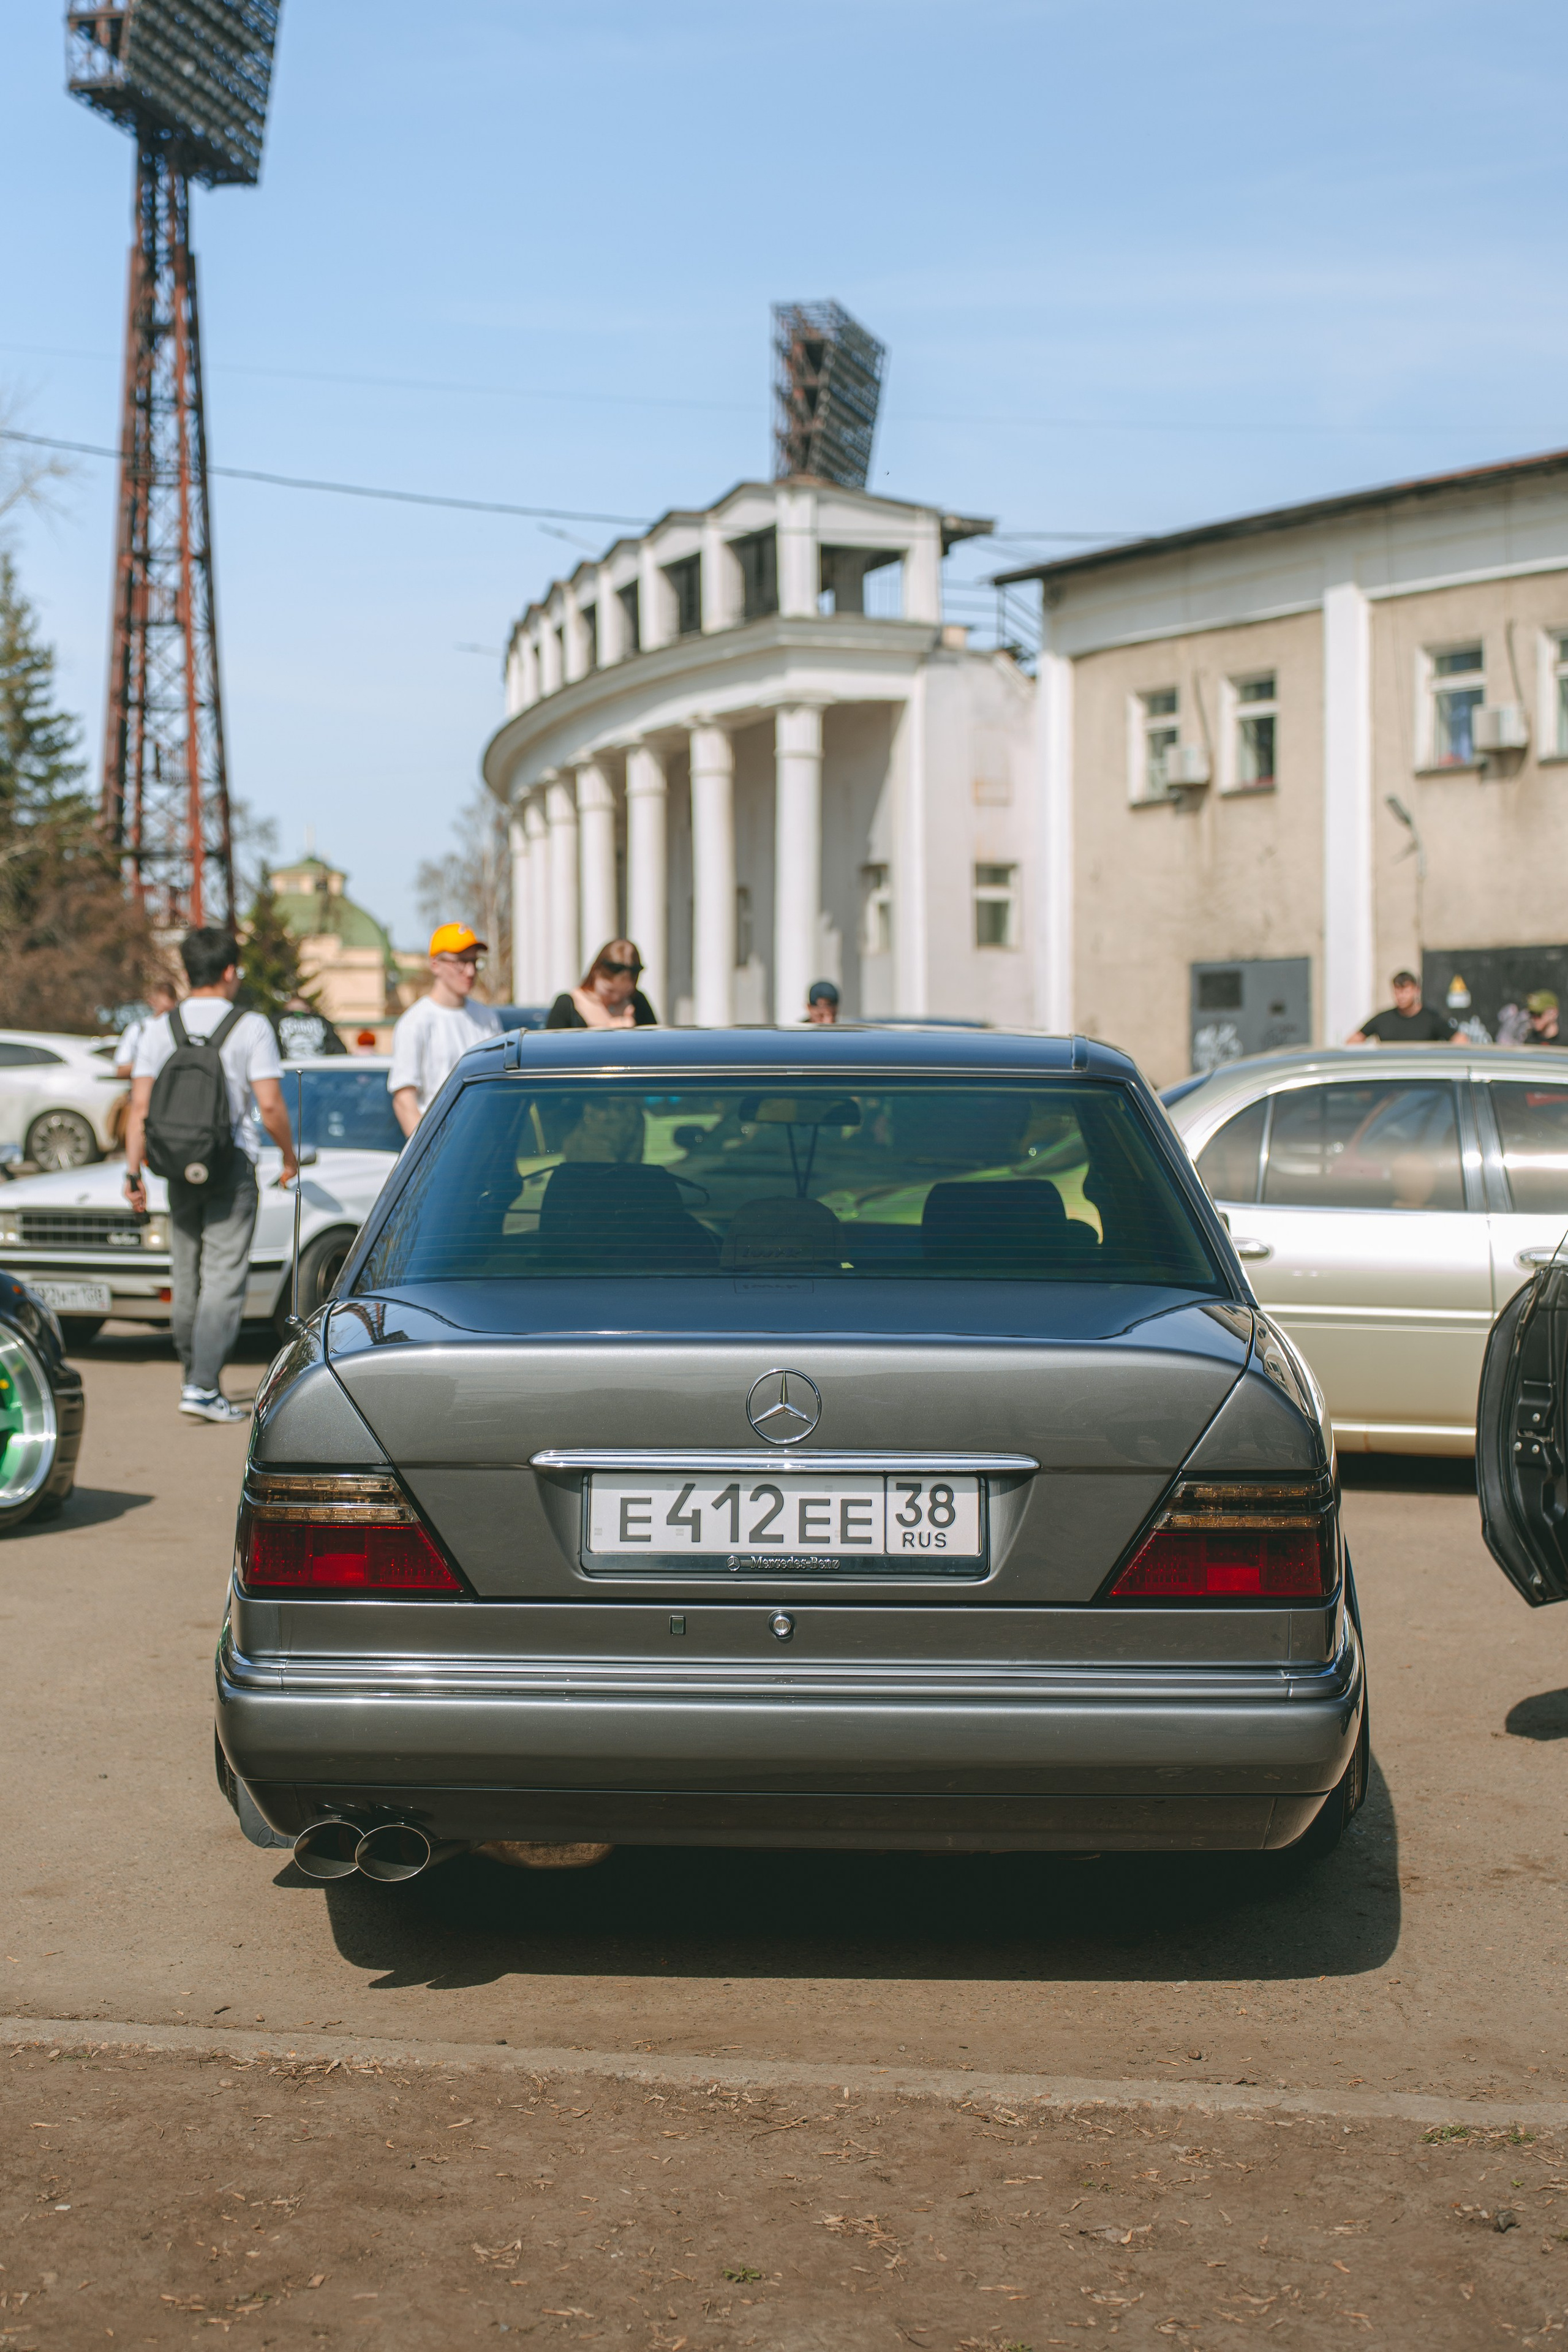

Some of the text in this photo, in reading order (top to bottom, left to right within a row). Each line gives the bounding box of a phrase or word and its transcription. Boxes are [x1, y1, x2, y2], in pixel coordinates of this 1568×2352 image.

[620, 1483, 956, 1544] E412EE 38
[902, 1532, 947, 1547] RUS
[750, 1556, 840, 1570] Mercedes-Benz
